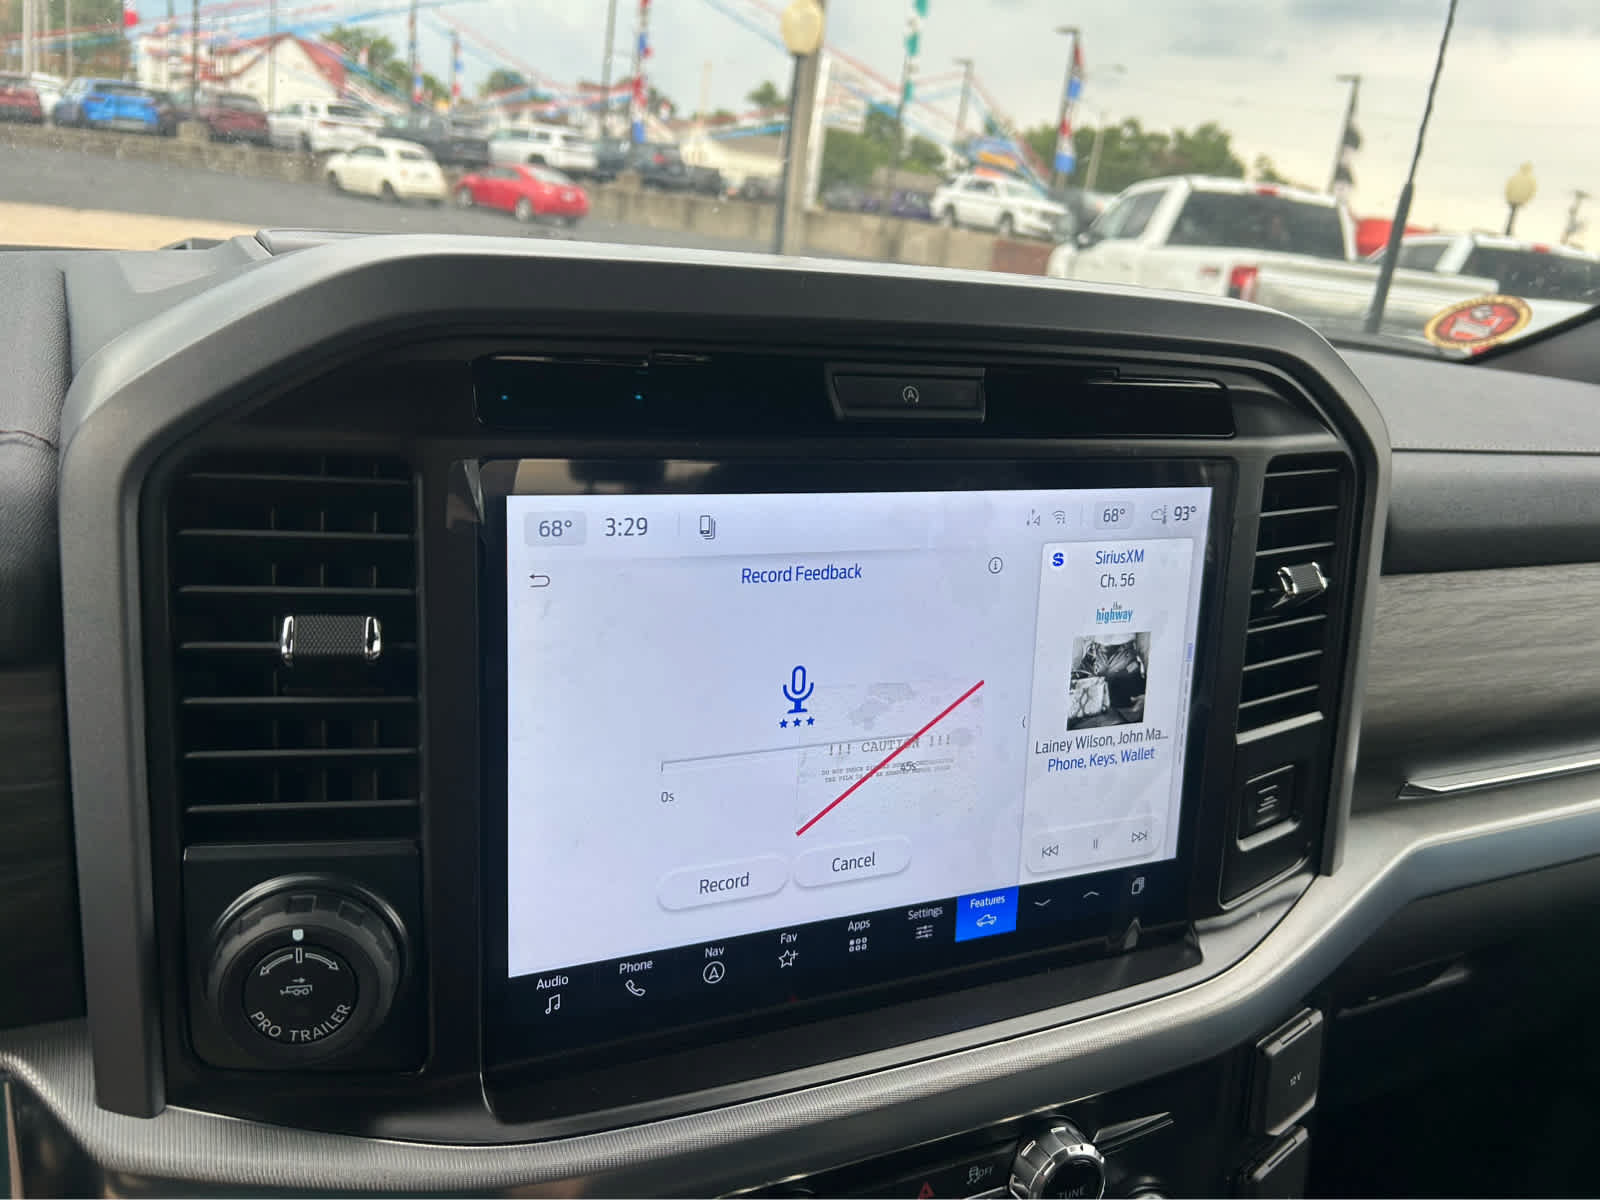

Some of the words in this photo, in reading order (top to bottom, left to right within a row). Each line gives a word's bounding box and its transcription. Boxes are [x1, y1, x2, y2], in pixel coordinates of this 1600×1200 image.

[1102, 508, 1126, 523] 68°
[1173, 506, 1198, 521] 93°
[538, 519, 573, 538] 68°
[604, 517, 649, 537] 3:29
[1095, 549, 1145, 565] SiriusXM
[741, 566, 792, 584] Record
[795, 563, 863, 581] Feedback
[1100, 574, 1117, 588] Ch.
[1120, 573, 1136, 587] 56
[1095, 608, 1134, 624] highway
[1035, 738, 1073, 754] Lainey
[1075, 733, 1116, 750] Wilson,
[1117, 730, 1143, 746] John
[1047, 755, 1087, 773] Phone,
[1089, 751, 1118, 768] Keys,
[1121, 747, 1155, 763] Wallet
[661, 791, 675, 803] 0s
[831, 852, 876, 873] Cancel
[699, 872, 750, 895] Record
[969, 895, 1005, 909] Features
[908, 906, 943, 921] Settings
[847, 918, 871, 932] Apps
[780, 933, 798, 944] Fav
[705, 947, 724, 958] Nav
[619, 959, 653, 975] Phone
[536, 974, 569, 990] Audio
[250, 1011, 282, 1038] PRO
[289, 1004, 351, 1042] TRAILER
